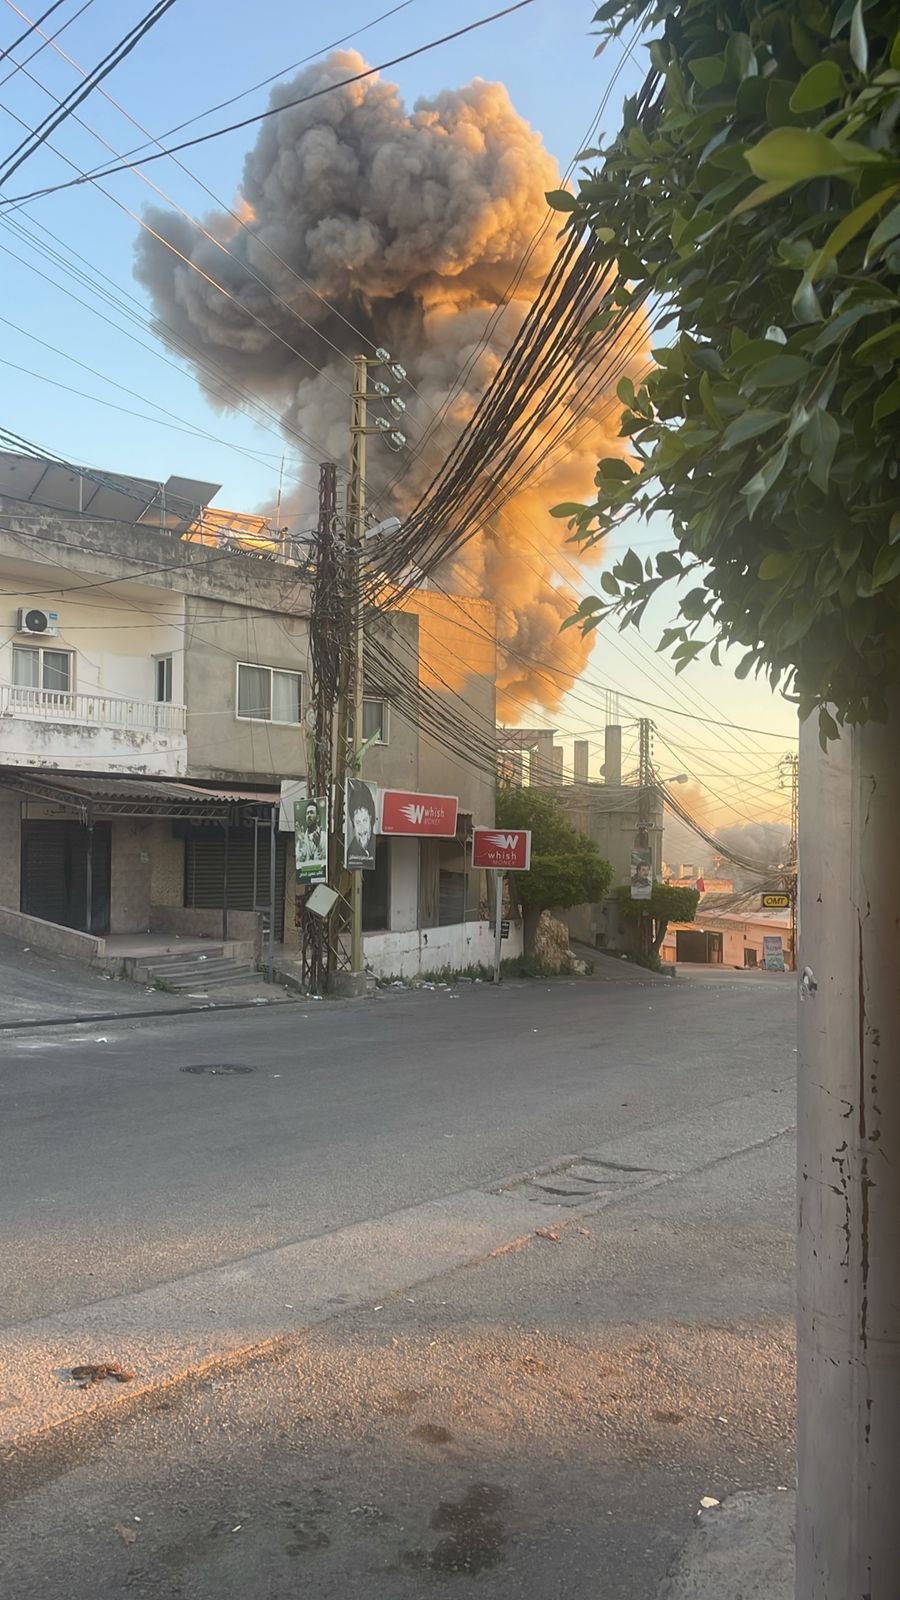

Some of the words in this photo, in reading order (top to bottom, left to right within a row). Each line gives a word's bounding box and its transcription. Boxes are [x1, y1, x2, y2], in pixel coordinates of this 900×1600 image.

[424, 806, 445, 818] whish
[487, 850, 517, 860] whish
[766, 897, 786, 905] OMT
